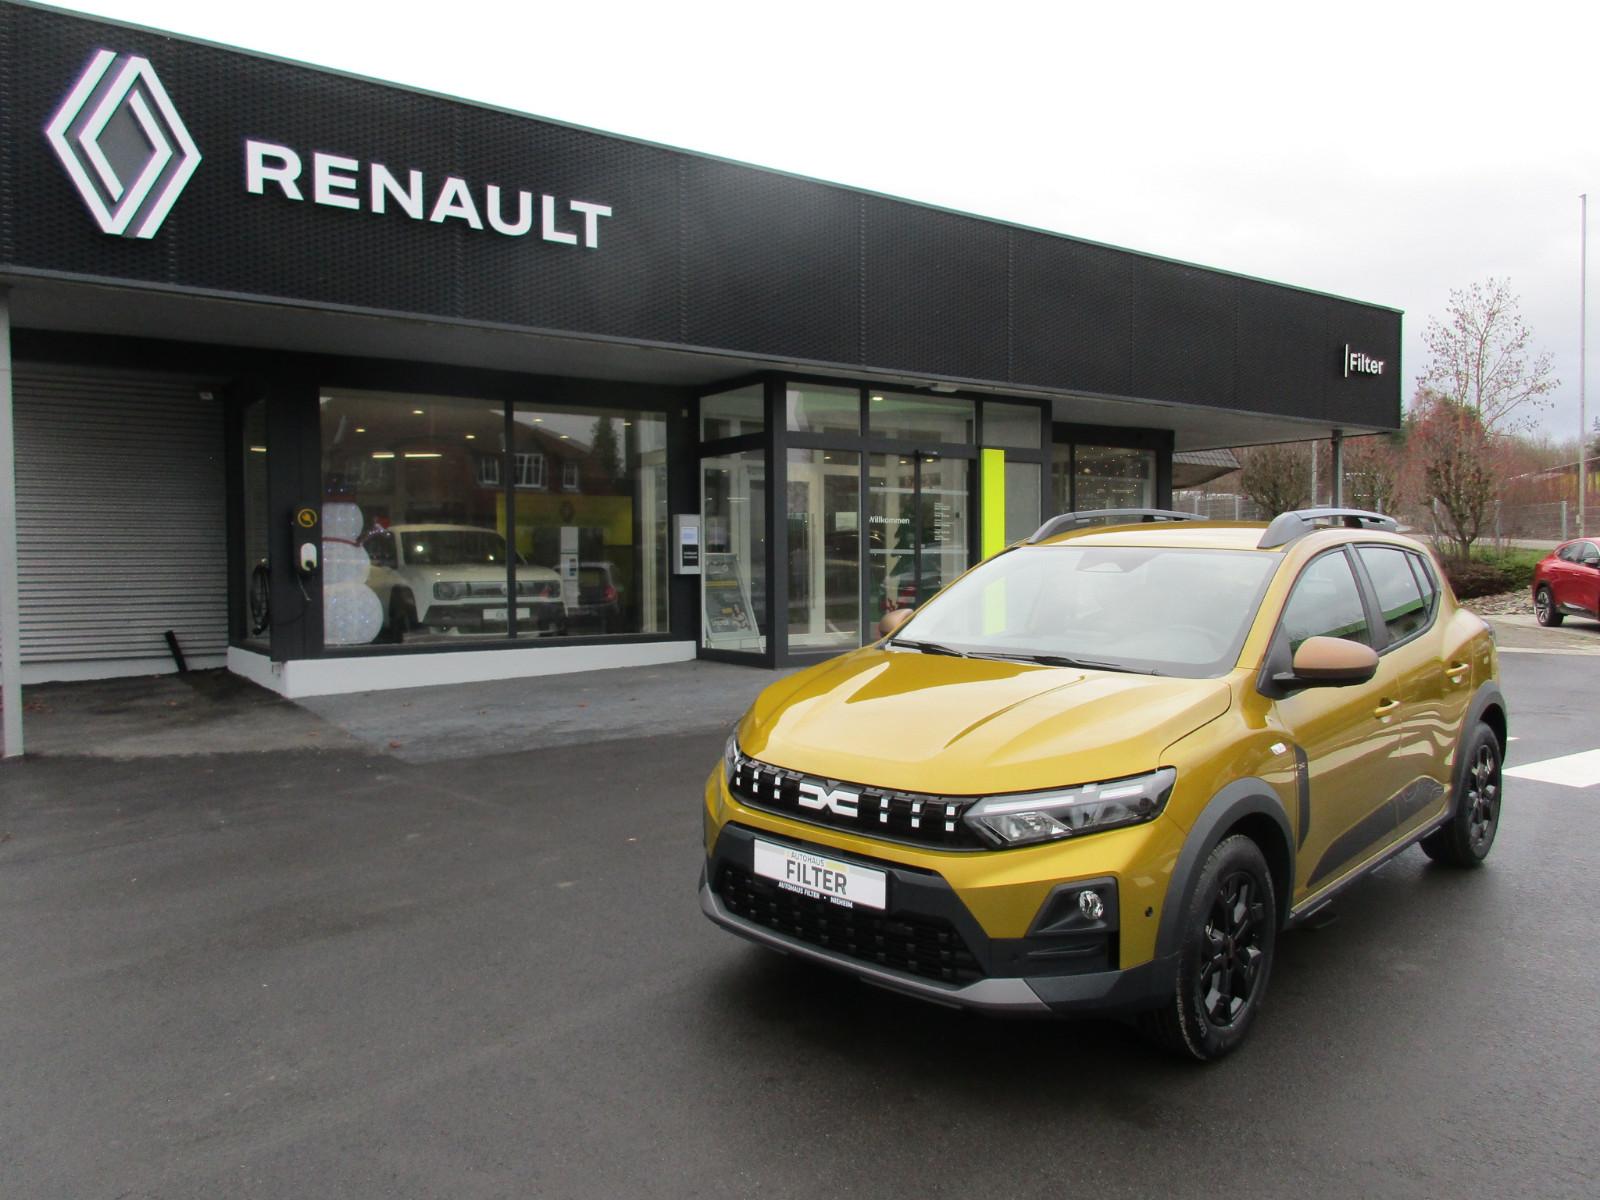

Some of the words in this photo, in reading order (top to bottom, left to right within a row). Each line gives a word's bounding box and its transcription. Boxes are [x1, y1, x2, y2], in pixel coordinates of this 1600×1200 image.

[244, 138, 612, 249] RENAULT
[1350, 352, 1384, 375] Filter
[869, 515, 910, 525] Willkommen
[791, 851, 825, 867] AUTOHAUS
[786, 859, 847, 895] FILTER
[778, 881, 803, 895] AUTOHAUS
[804, 889, 820, 900] FILTER
